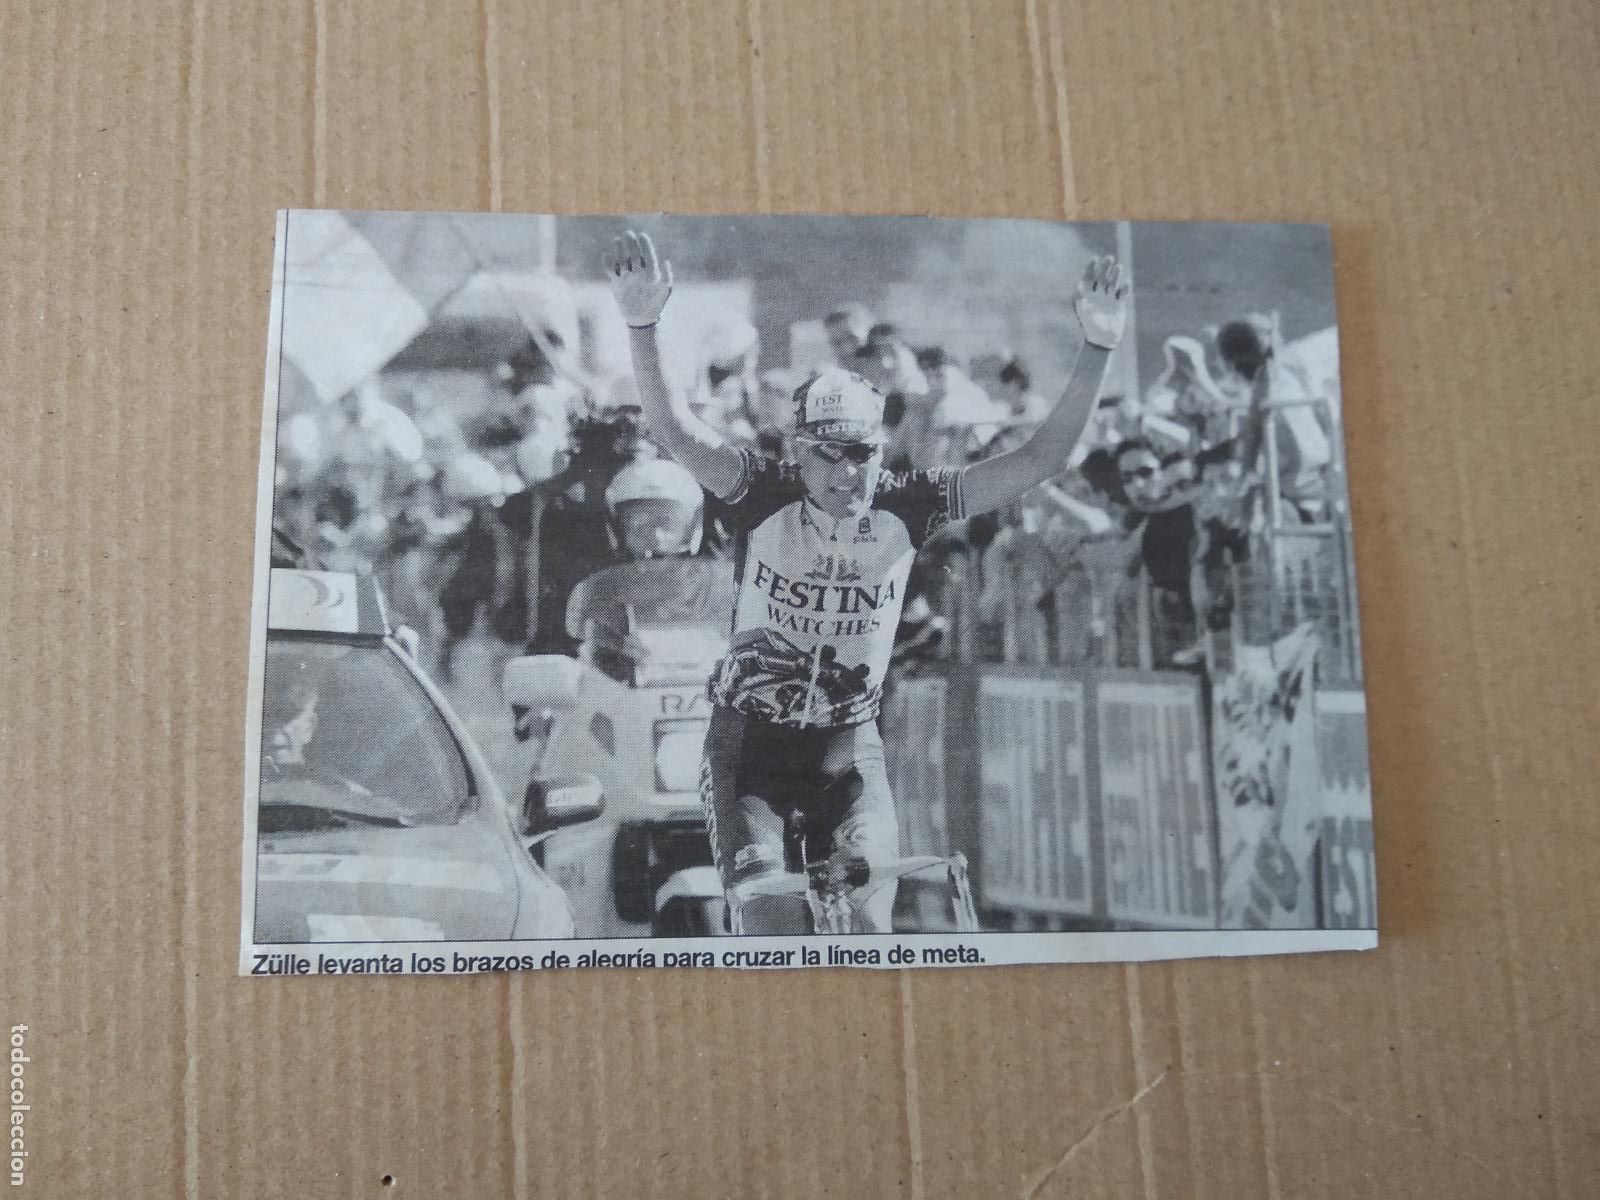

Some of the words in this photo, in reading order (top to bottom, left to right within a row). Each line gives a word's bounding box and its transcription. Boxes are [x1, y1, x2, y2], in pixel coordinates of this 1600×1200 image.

[753, 559, 896, 613] FESTINA
[767, 602, 880, 636] WATCHES
[251, 953, 310, 975] Zülle
[318, 953, 403, 975] levanta
[411, 952, 446, 973] los
[453, 951, 534, 972] brazos
[541, 950, 571, 970] de
[577, 947, 657, 969] alegría
[663, 951, 716, 968] para
[722, 949, 796, 967] cruzar
[801, 945, 821, 966] la
[828, 944, 881, 965] línea
[887, 944, 916, 964] de
[922, 943, 986, 964] meta.
